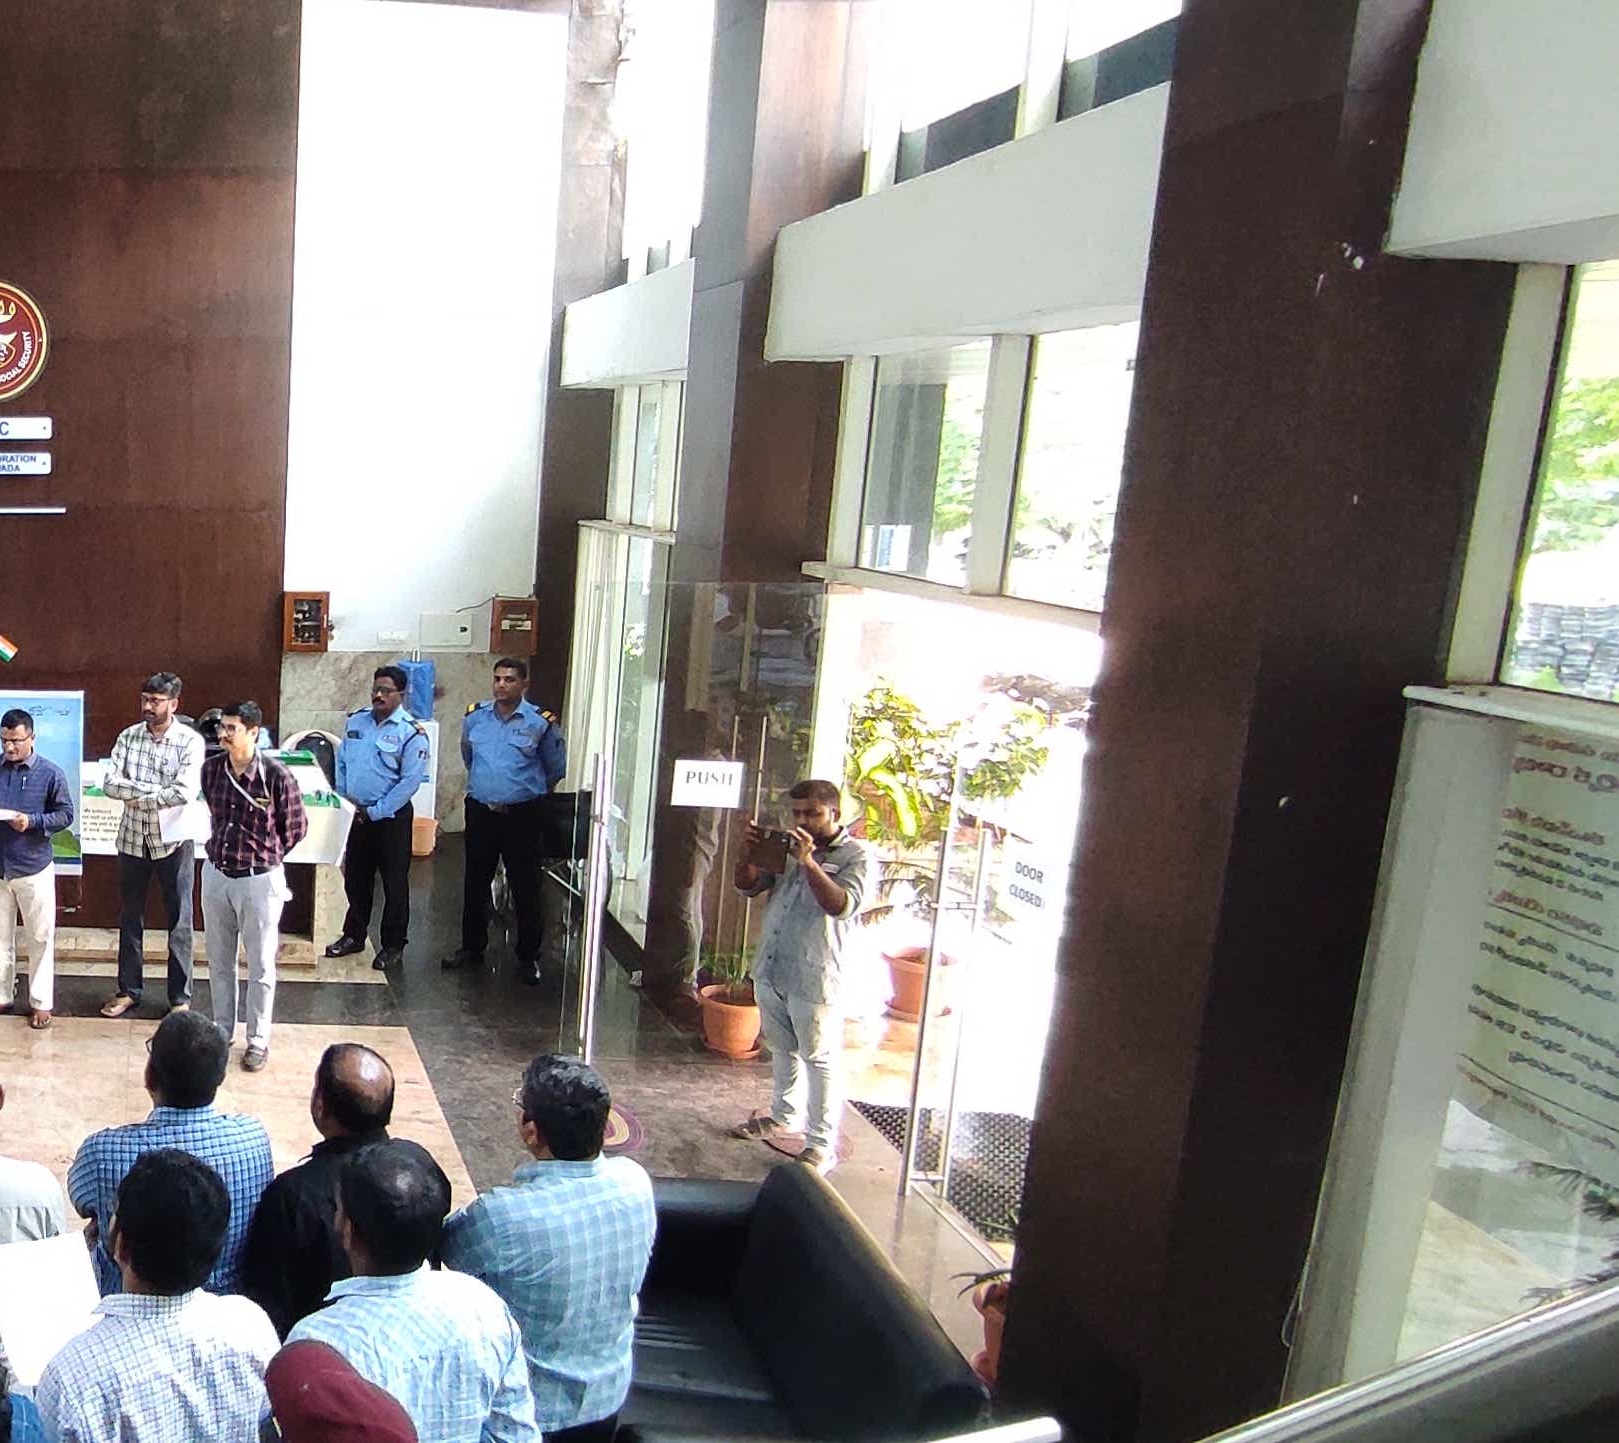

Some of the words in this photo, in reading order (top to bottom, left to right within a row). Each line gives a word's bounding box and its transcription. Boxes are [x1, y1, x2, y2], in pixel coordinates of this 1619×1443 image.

[18, 331, 33, 369] SECURITY
[686, 770, 733, 786] PUSH
[1015, 861, 1043, 884] DOOR
[1009, 884, 1042, 908] CLOSED
